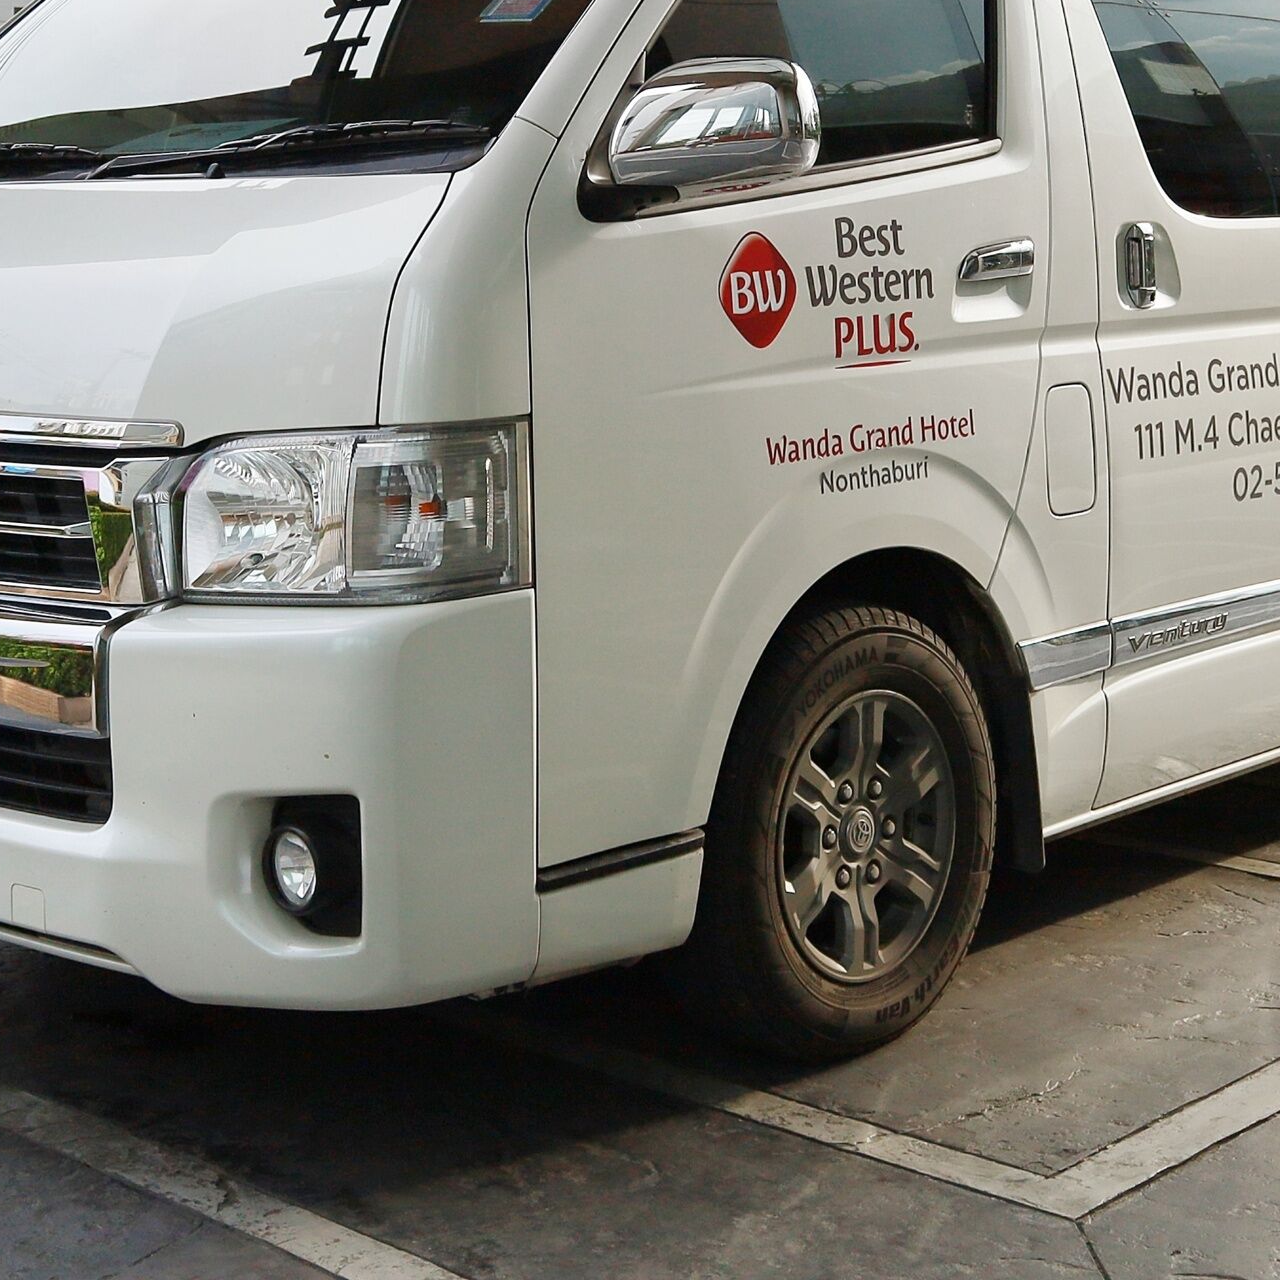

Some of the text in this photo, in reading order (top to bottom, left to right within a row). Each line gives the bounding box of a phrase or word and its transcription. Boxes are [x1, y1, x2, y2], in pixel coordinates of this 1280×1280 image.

[834, 216, 906, 259] Best
[729, 268, 787, 315] BW
[804, 264, 935, 308] Western
[1105, 361, 1200, 405] Wanda
[1207, 352, 1280, 394] Grand
[766, 408, 976, 466] Wanda Grand Hotel
[1133, 421, 1166, 460] 111
[1174, 415, 1220, 455] M.4
[819, 455, 929, 495] Nonthaburi
[795, 643, 880, 719] YOKOHAMA
